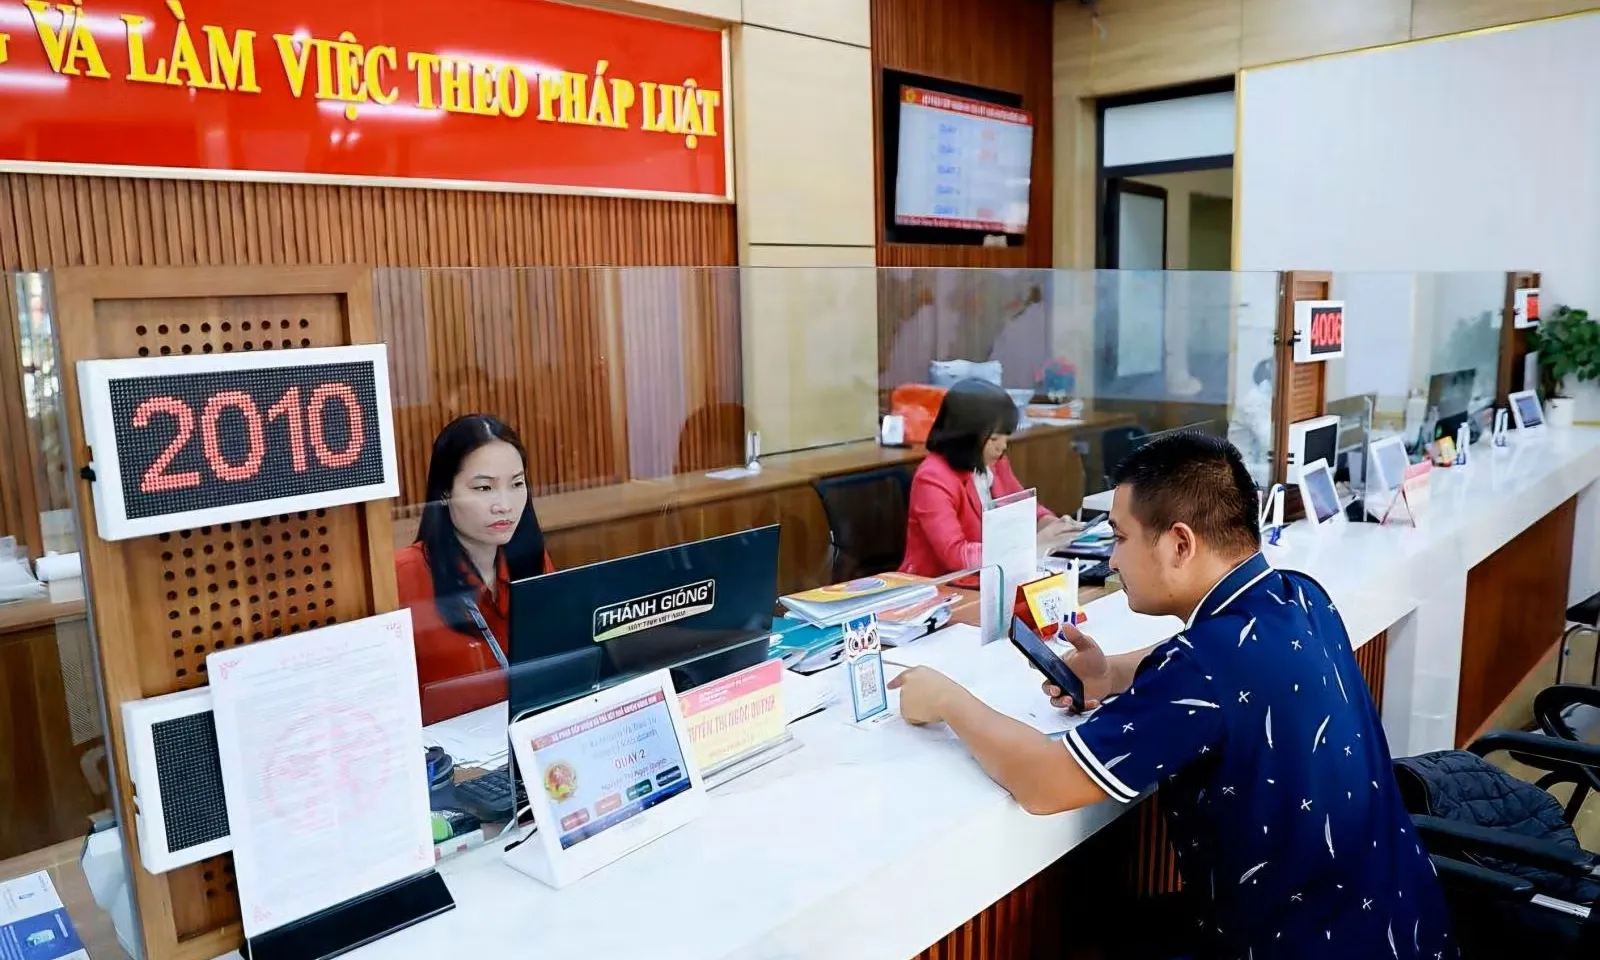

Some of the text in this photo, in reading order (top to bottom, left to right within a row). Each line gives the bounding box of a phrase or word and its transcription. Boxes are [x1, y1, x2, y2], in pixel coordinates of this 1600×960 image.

[23, 0, 111, 79] VÀ
[120, 0, 262, 93] LÀM
[272, 31, 399, 120] VIỆC
[407, 52, 528, 118] THEO
[536, 60, 635, 129] PHÁP
[639, 77, 720, 149] LUẬT
[132, 382, 365, 493] 2010
[599, 599, 657, 627] THÁNH
